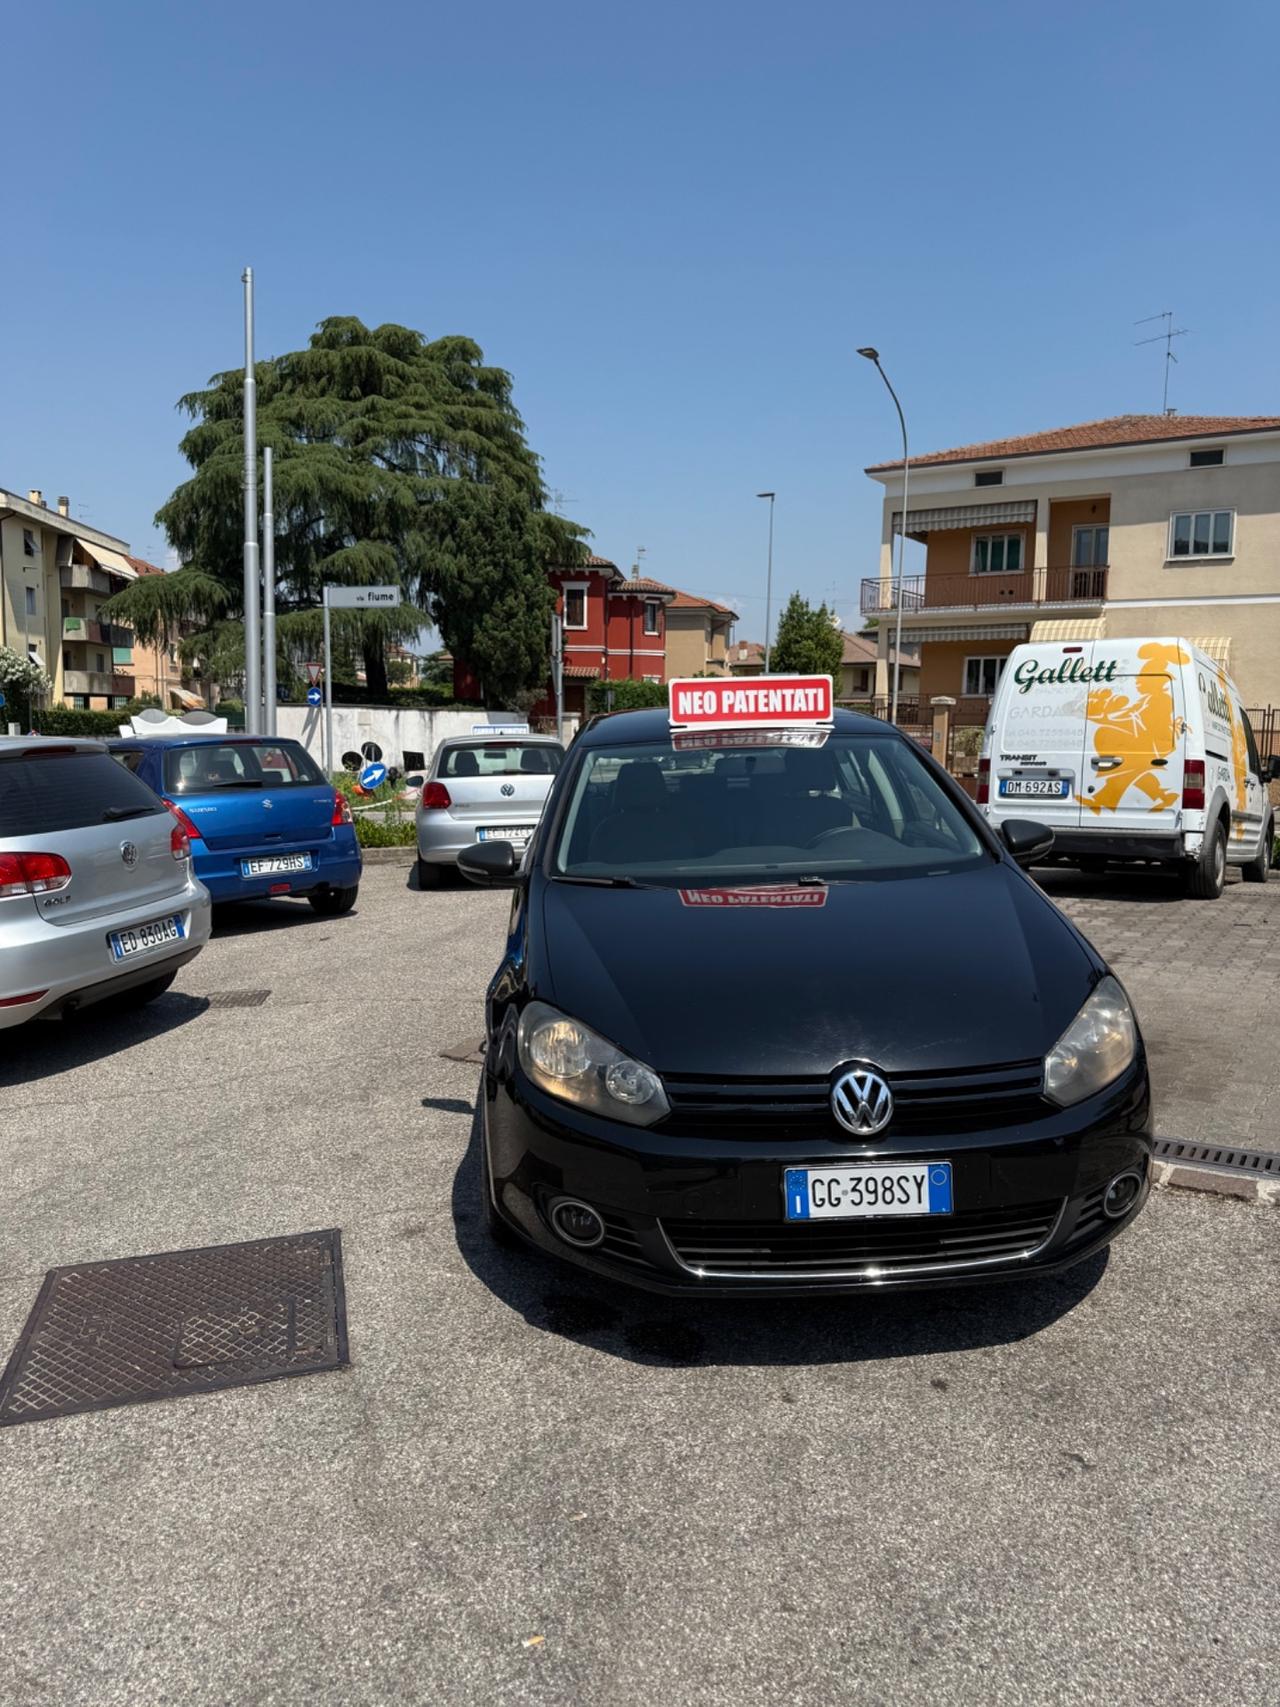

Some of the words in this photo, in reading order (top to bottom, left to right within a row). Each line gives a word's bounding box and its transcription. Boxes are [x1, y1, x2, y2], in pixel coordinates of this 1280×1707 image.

[367, 591, 394, 601] fiume
[1013, 656, 1117, 695] Gallett
[678, 690, 717, 716] NEO
[722, 687, 825, 714] PATENTATI
[1000, 754, 1038, 762] TRANSIT
[1008, 781, 1022, 793] DM
[1025, 781, 1061, 793] 692AS
[250, 859, 264, 873] EF
[268, 856, 303, 871] 729HS
[120, 931, 138, 954] ED
[139, 919, 177, 946] 830AG
[811, 1177, 842, 1208] GG
[849, 1174, 926, 1206] 398SY
